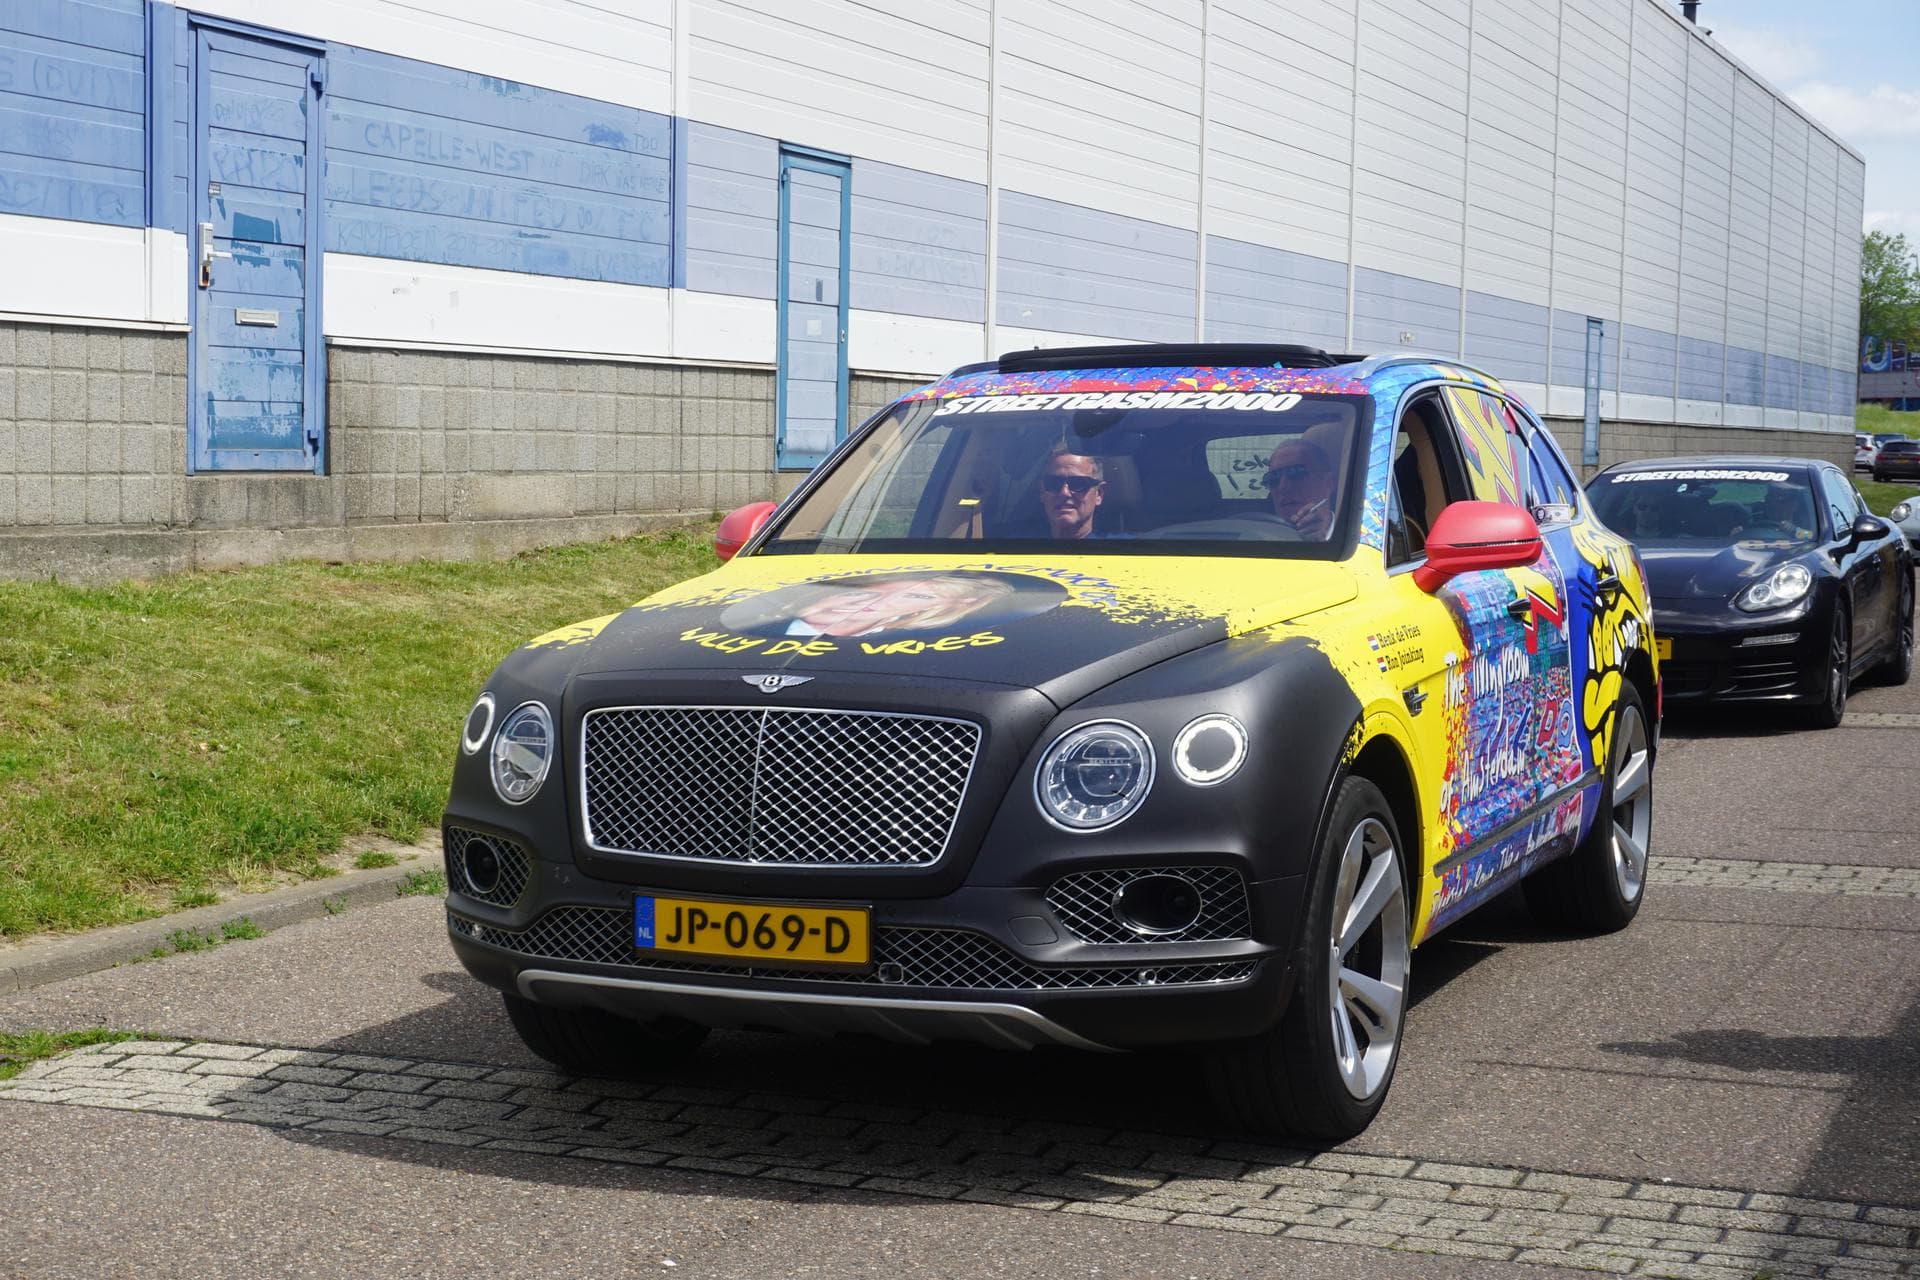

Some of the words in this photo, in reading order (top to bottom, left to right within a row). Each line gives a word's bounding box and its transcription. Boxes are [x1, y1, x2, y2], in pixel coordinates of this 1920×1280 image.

[363, 121, 535, 174] CAPELLE-WEST
[933, 392, 1303, 416] STREETGASM2000
[761, 640, 839, 656] DE
[860, 631, 1005, 655] VRIES
[1462, 719, 1526, 804] Amsterdam
[638, 927, 654, 940] NL
[666, 907, 850, 954] JP-069-D
